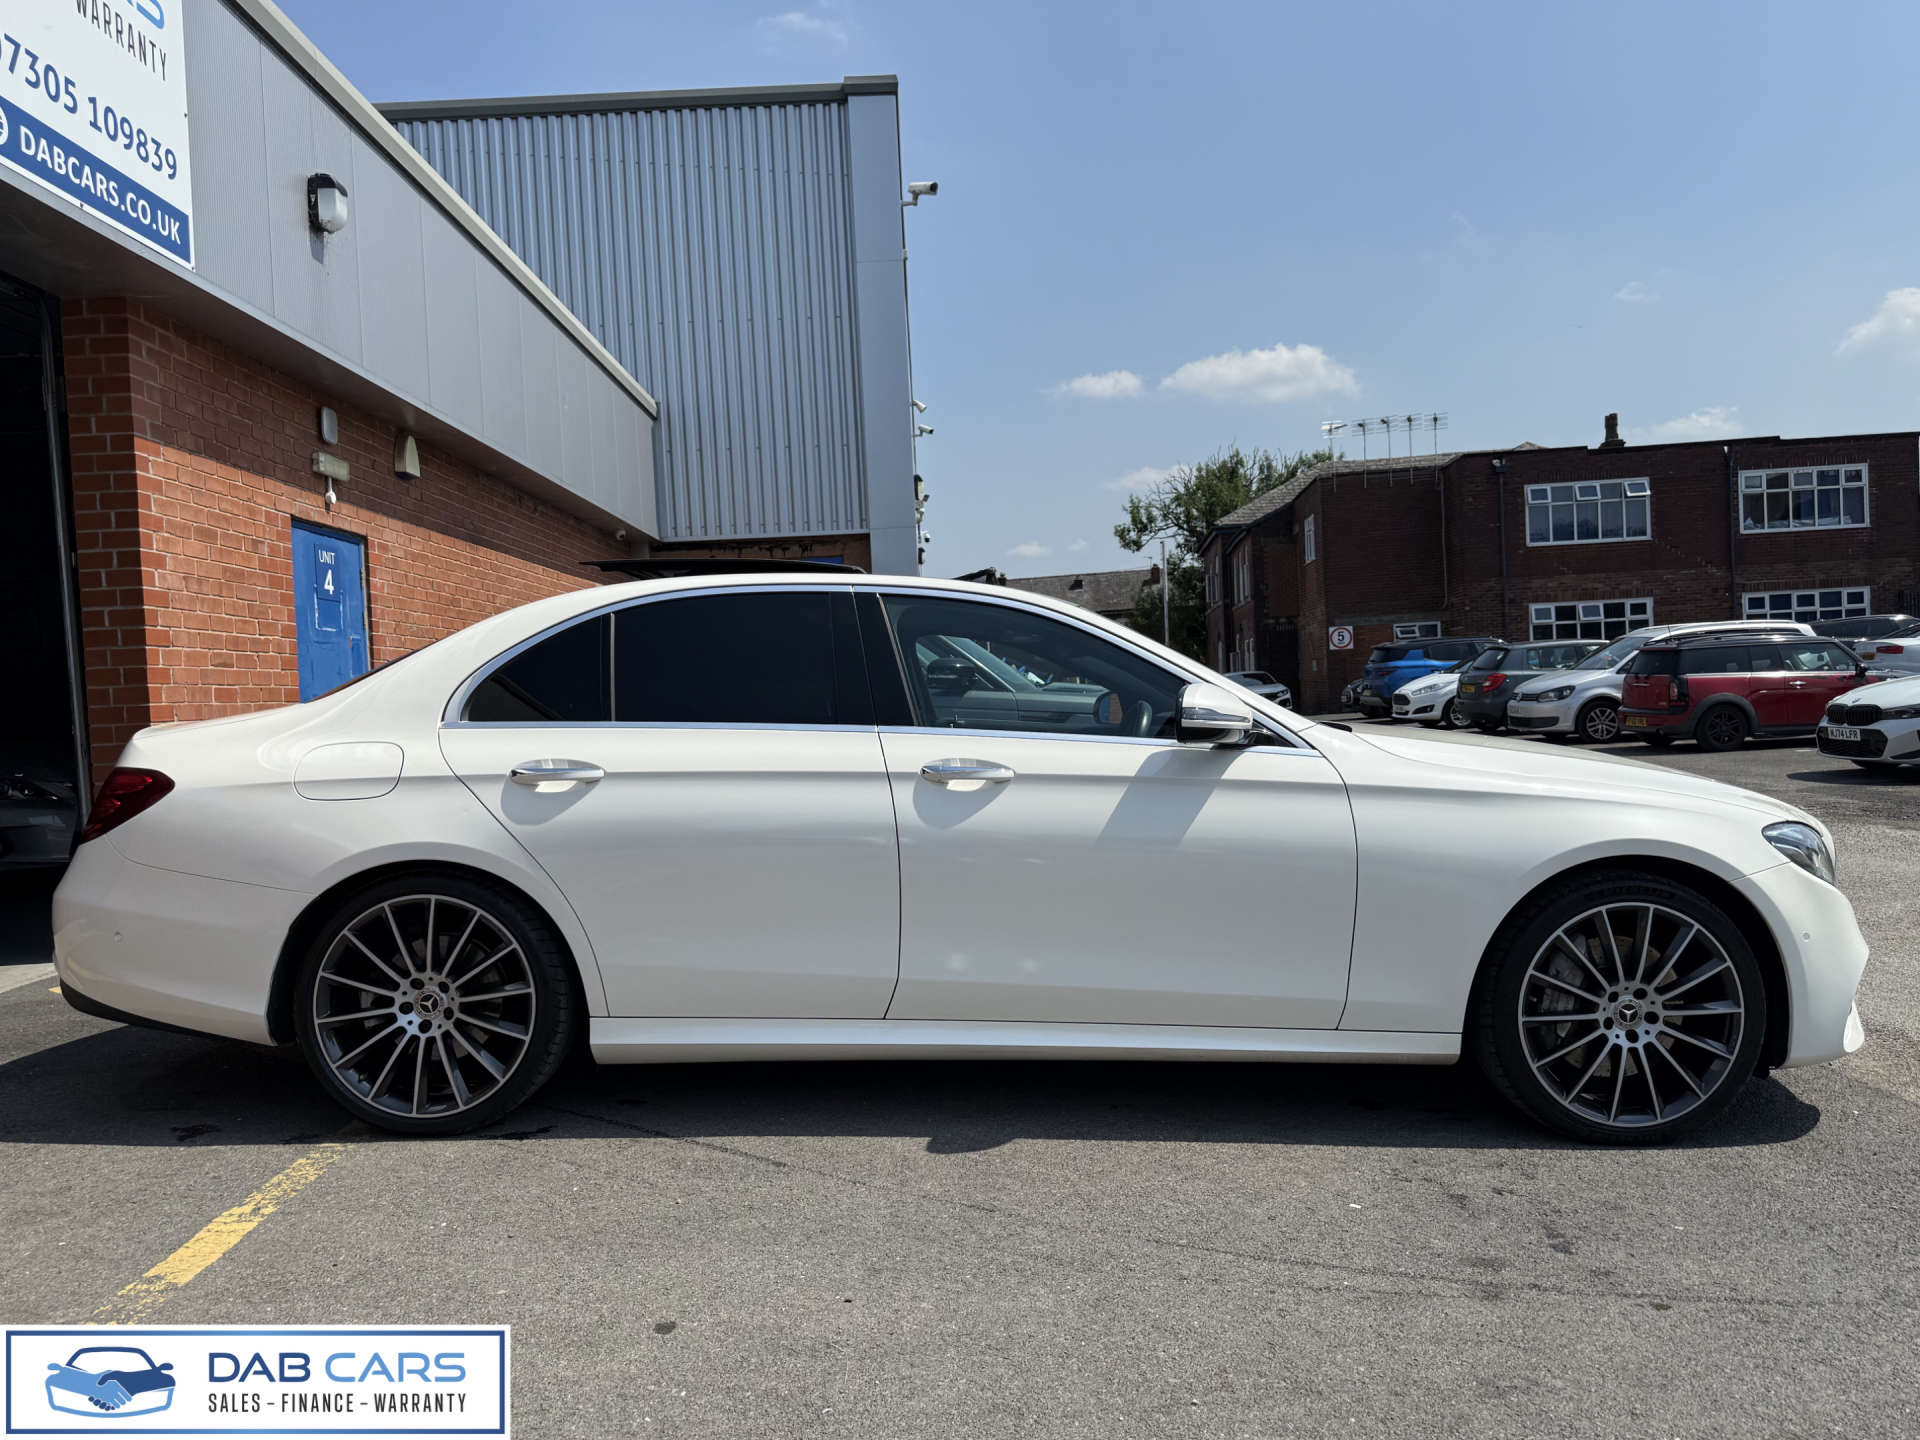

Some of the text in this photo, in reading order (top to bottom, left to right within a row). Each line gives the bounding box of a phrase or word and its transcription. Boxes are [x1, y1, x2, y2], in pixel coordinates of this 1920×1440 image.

[0, 32, 177, 180] 7305 109839
[19, 125, 181, 245] DABCARS.CO.UK
[318, 549, 336, 565] UNIT
[324, 569, 334, 595] 4
[1337, 631, 1345, 642] 5
